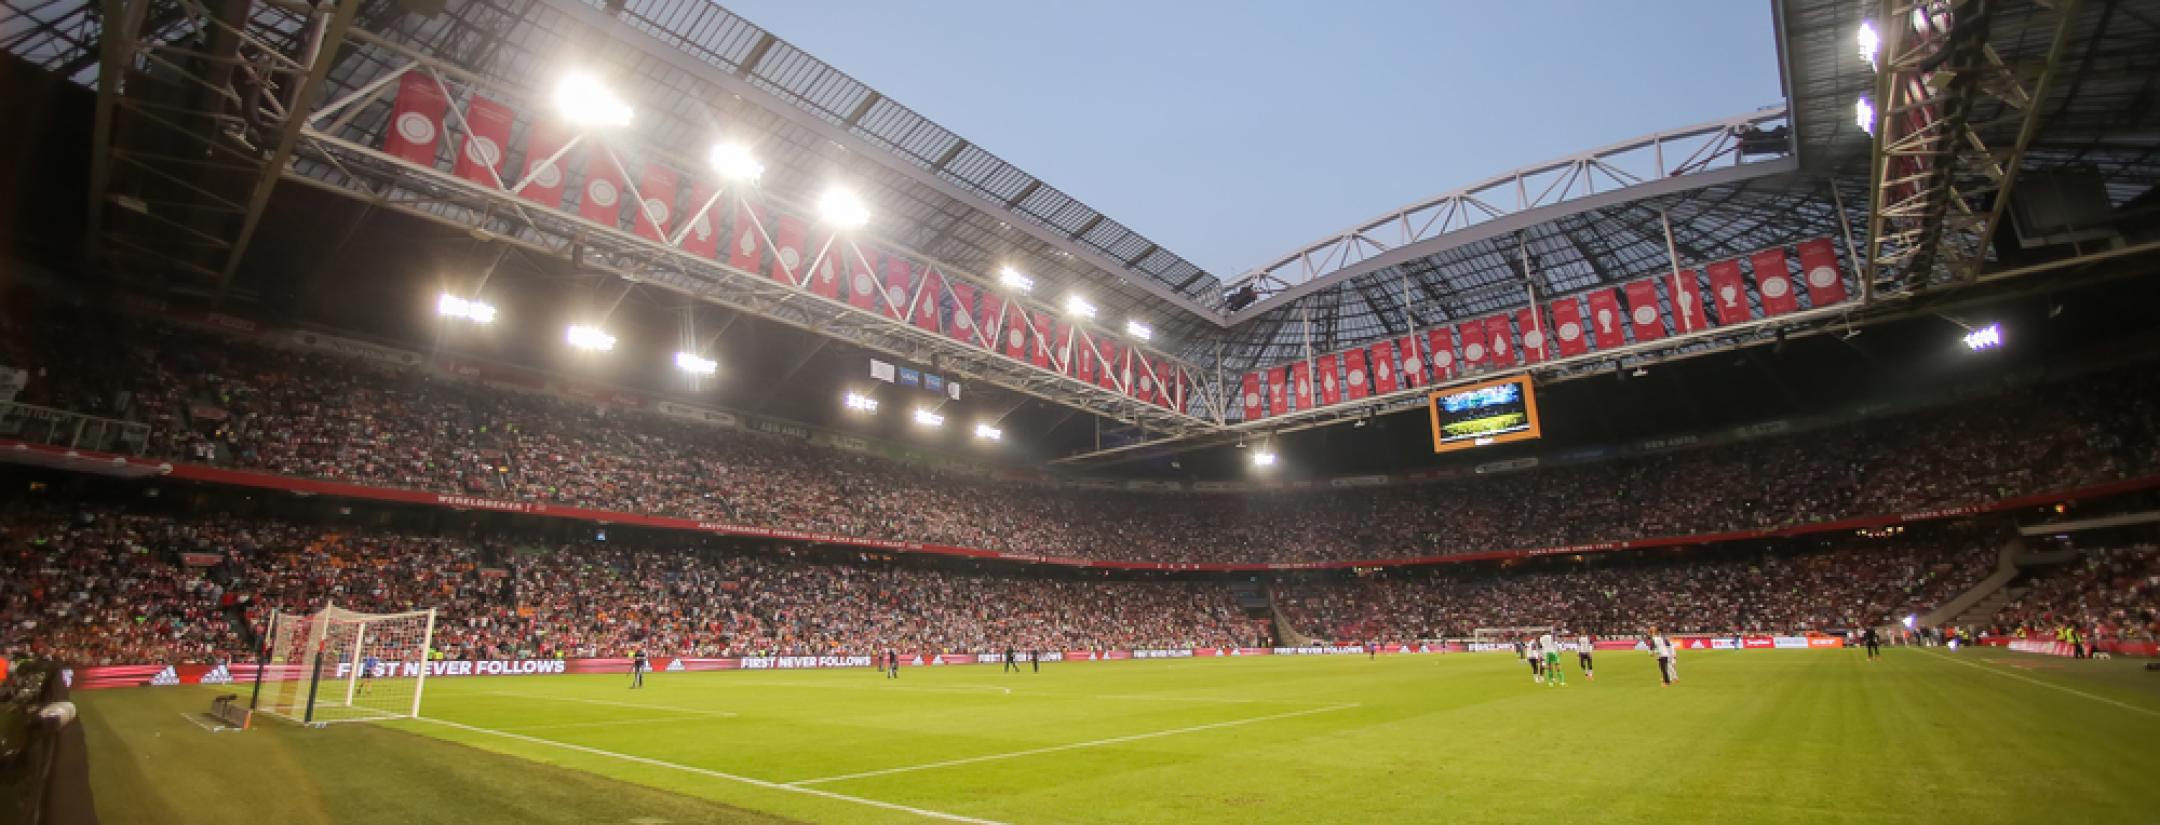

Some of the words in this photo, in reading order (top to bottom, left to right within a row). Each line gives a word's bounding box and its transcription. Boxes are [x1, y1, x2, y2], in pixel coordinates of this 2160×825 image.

[336, 661, 400, 678] FST
[403, 660, 471, 677] NEVER
[476, 660, 565, 674] FOLLOWS
[741, 656, 777, 669] FIRST
[777, 656, 817, 668] NEVER
[818, 655, 871, 667] FOLLOWS
